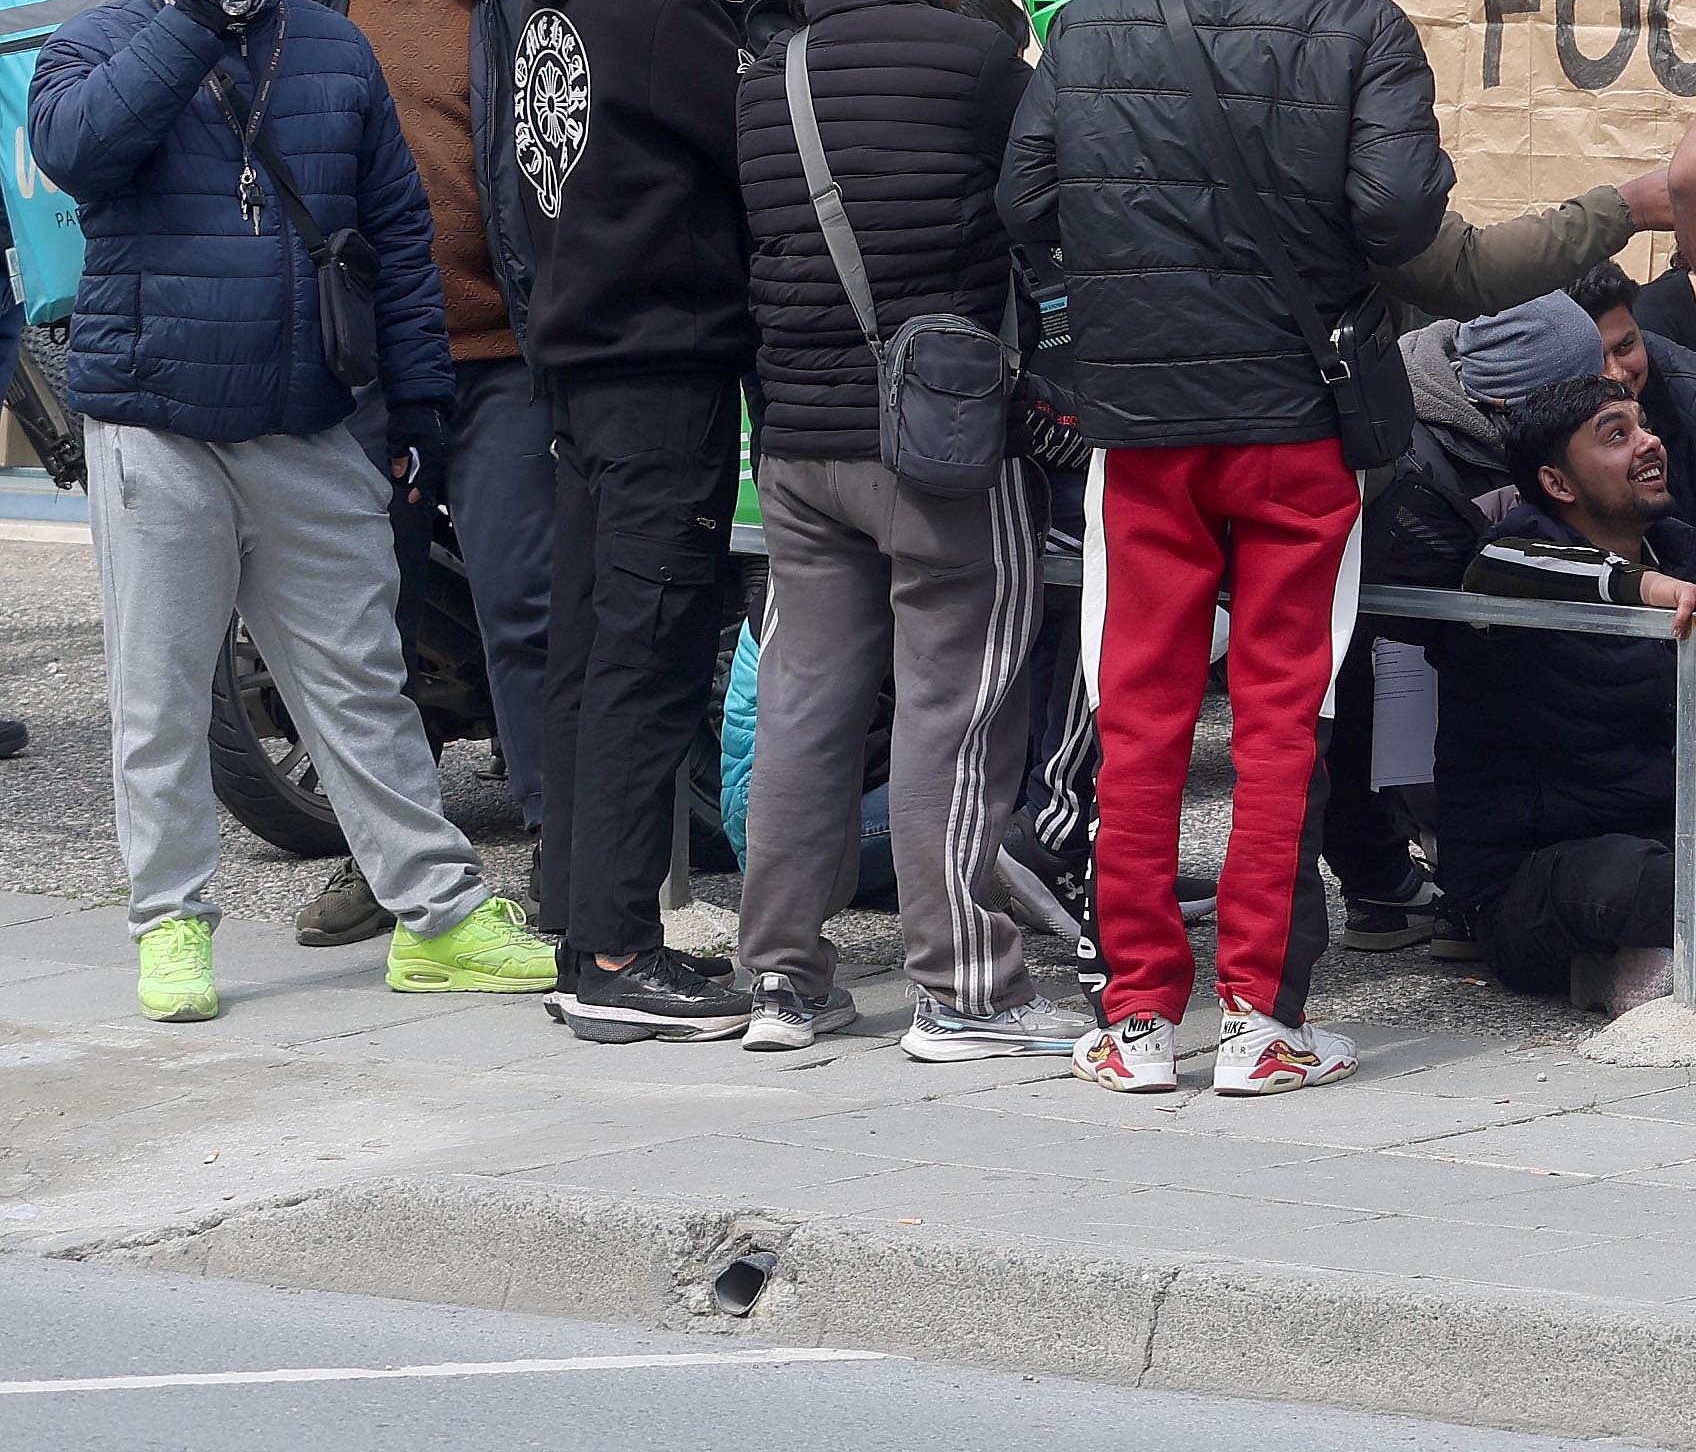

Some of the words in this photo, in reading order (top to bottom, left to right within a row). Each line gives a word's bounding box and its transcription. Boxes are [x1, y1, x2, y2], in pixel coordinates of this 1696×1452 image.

[1128, 1017, 1157, 1033] NIKE
[1223, 1021, 1247, 1034] NIKE
[1131, 1042, 1161, 1052] AIR
